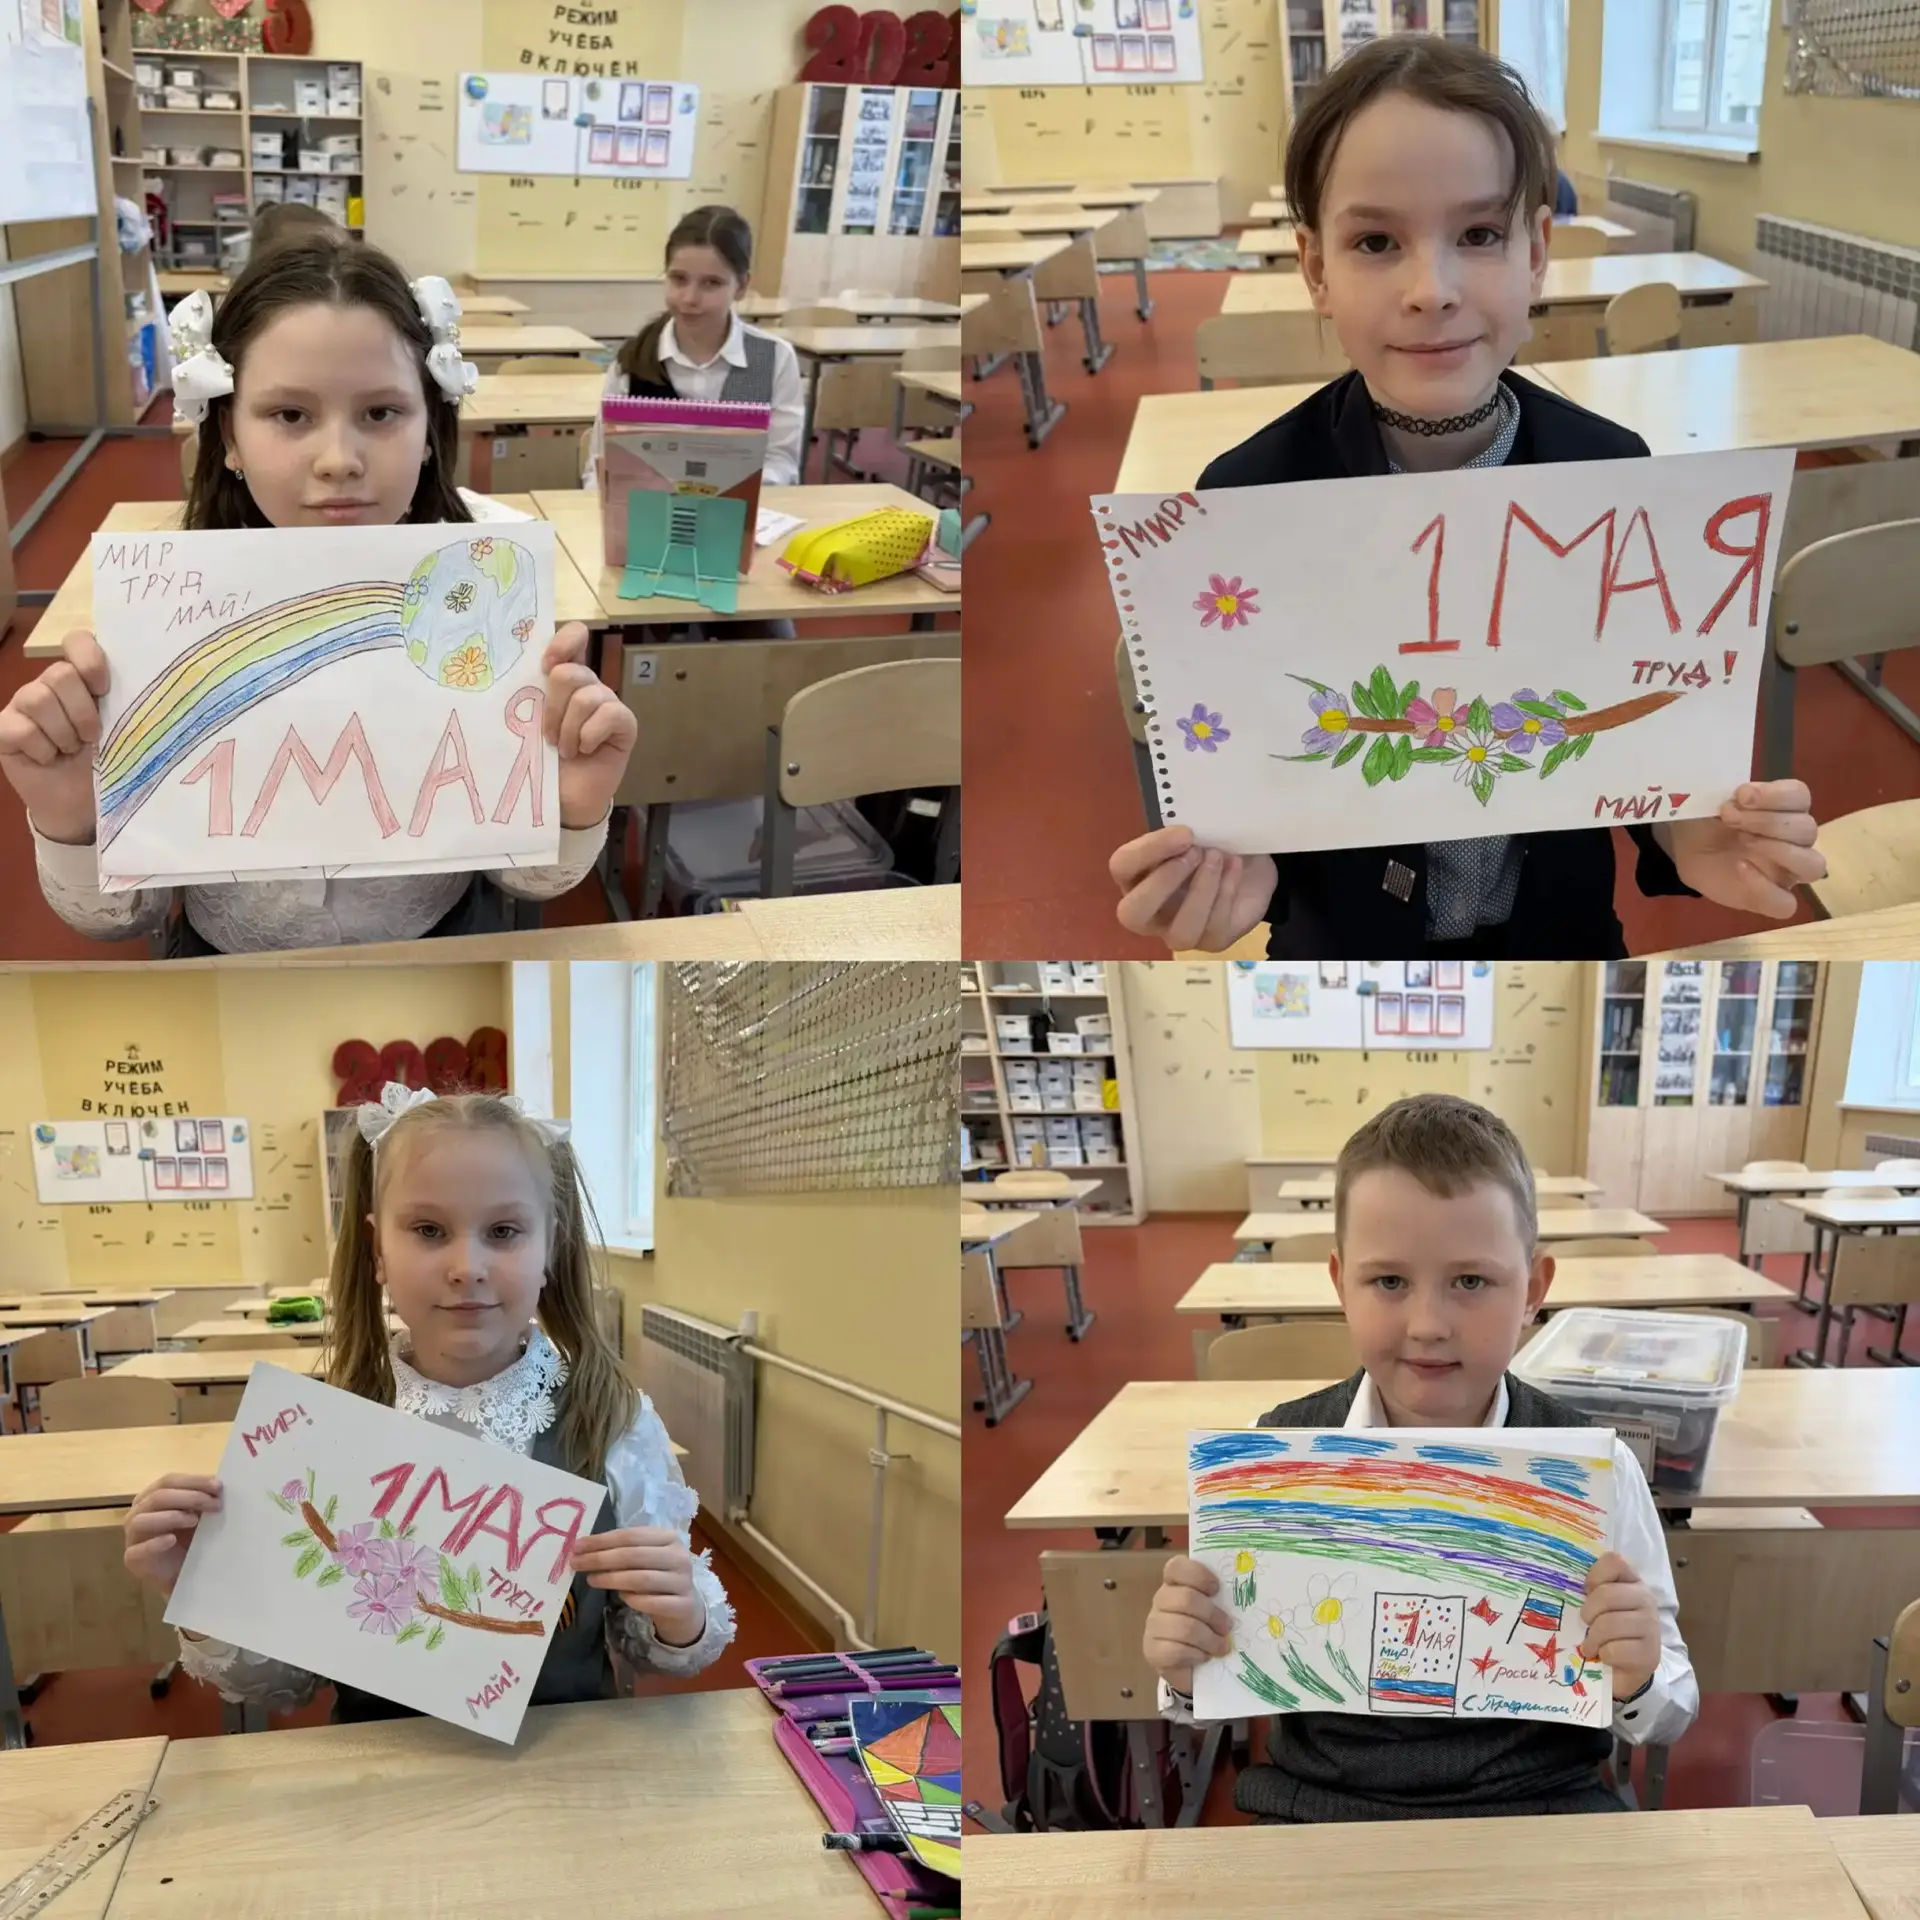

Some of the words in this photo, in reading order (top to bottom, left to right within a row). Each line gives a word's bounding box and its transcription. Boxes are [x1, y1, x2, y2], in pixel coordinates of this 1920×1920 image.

[554, 5, 618, 25] РЕЖИМ
[798, 4, 960, 88] 202
[1116, 491, 1207, 558] МИР!
[99, 542, 174, 570] МИР
[121, 570, 203, 603] ТРУД
[166, 591, 250, 632] МАЙ!
[639, 661, 650, 678] 2
[1594, 785, 1691, 819] МАЙ!
[106, 1060, 164, 1075] РЕЖИМ
[241, 1403, 314, 1458] МИР!
[487, 1566, 545, 1618] ТРУД!
[465, 1660, 521, 1719] МАЙ!
